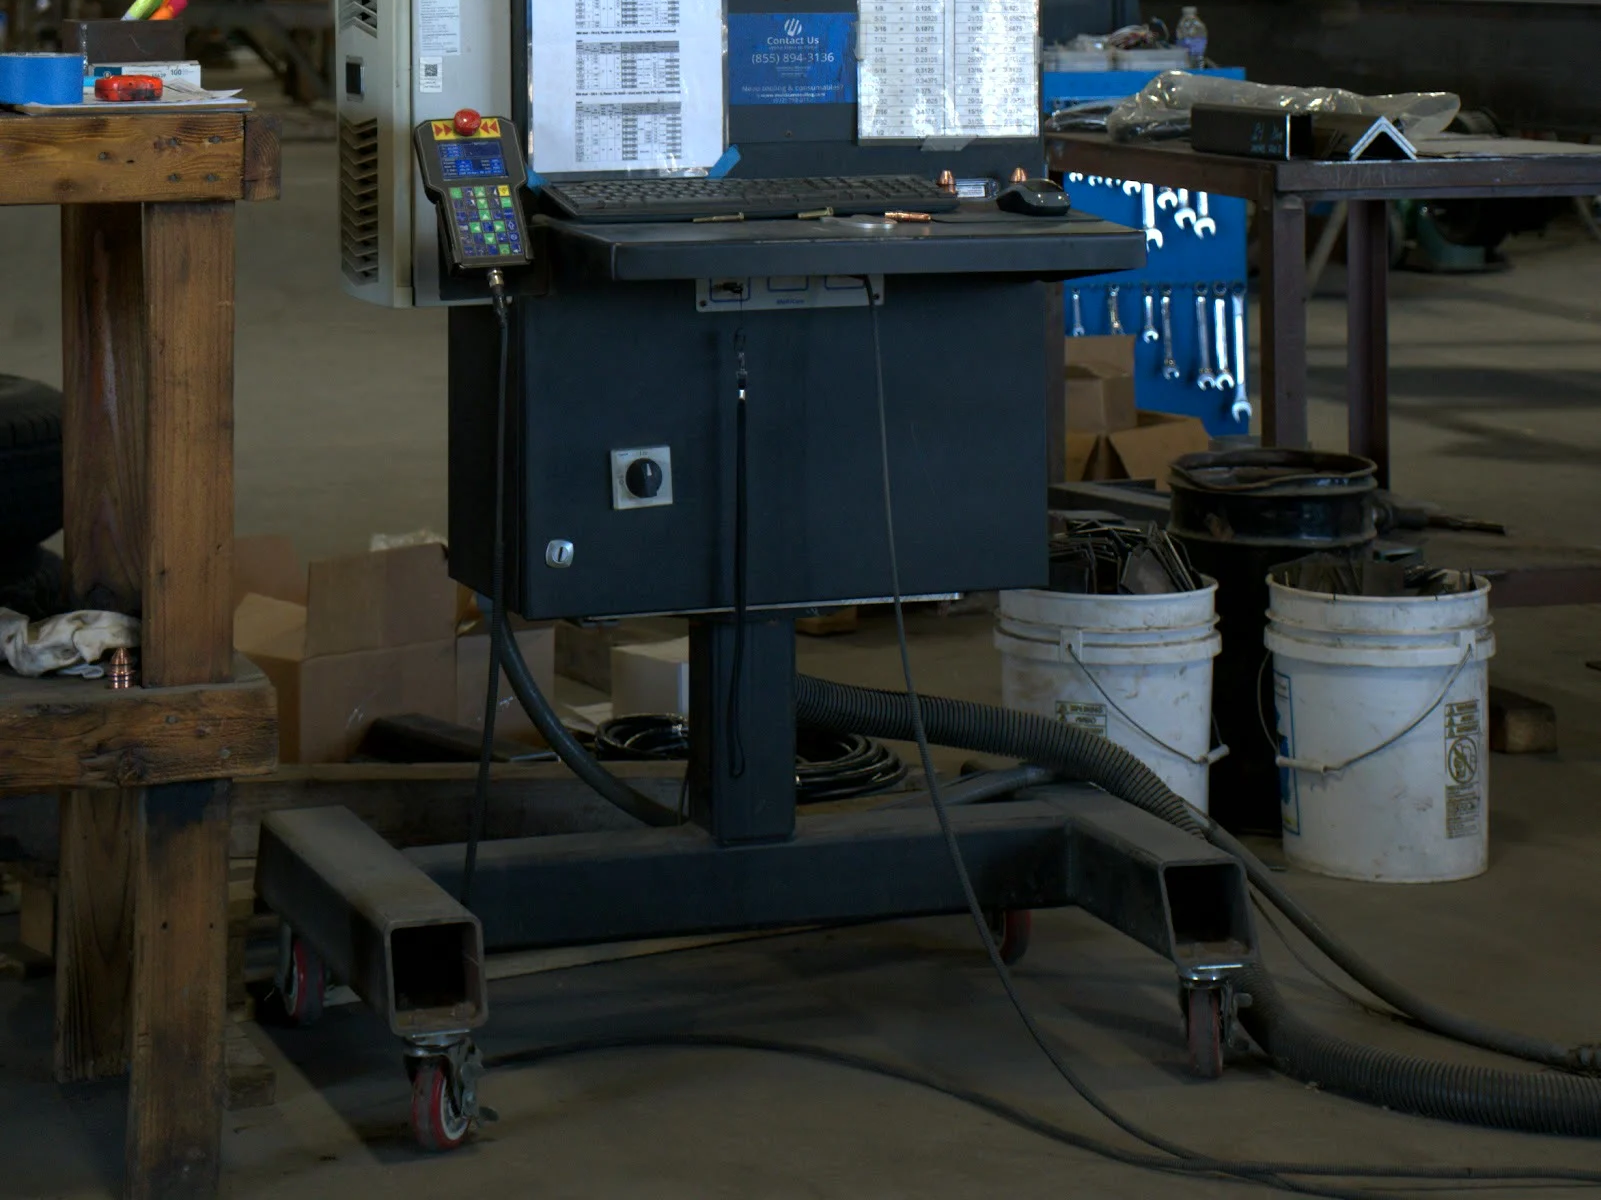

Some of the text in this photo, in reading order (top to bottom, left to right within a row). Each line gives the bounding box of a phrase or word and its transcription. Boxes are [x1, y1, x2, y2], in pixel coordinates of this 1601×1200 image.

[766, 36, 819, 45] Contact Us
[751, 52, 835, 64] (855) 894-3136
[762, 84, 787, 93] tooling
[794, 83, 844, 92] consumables?
